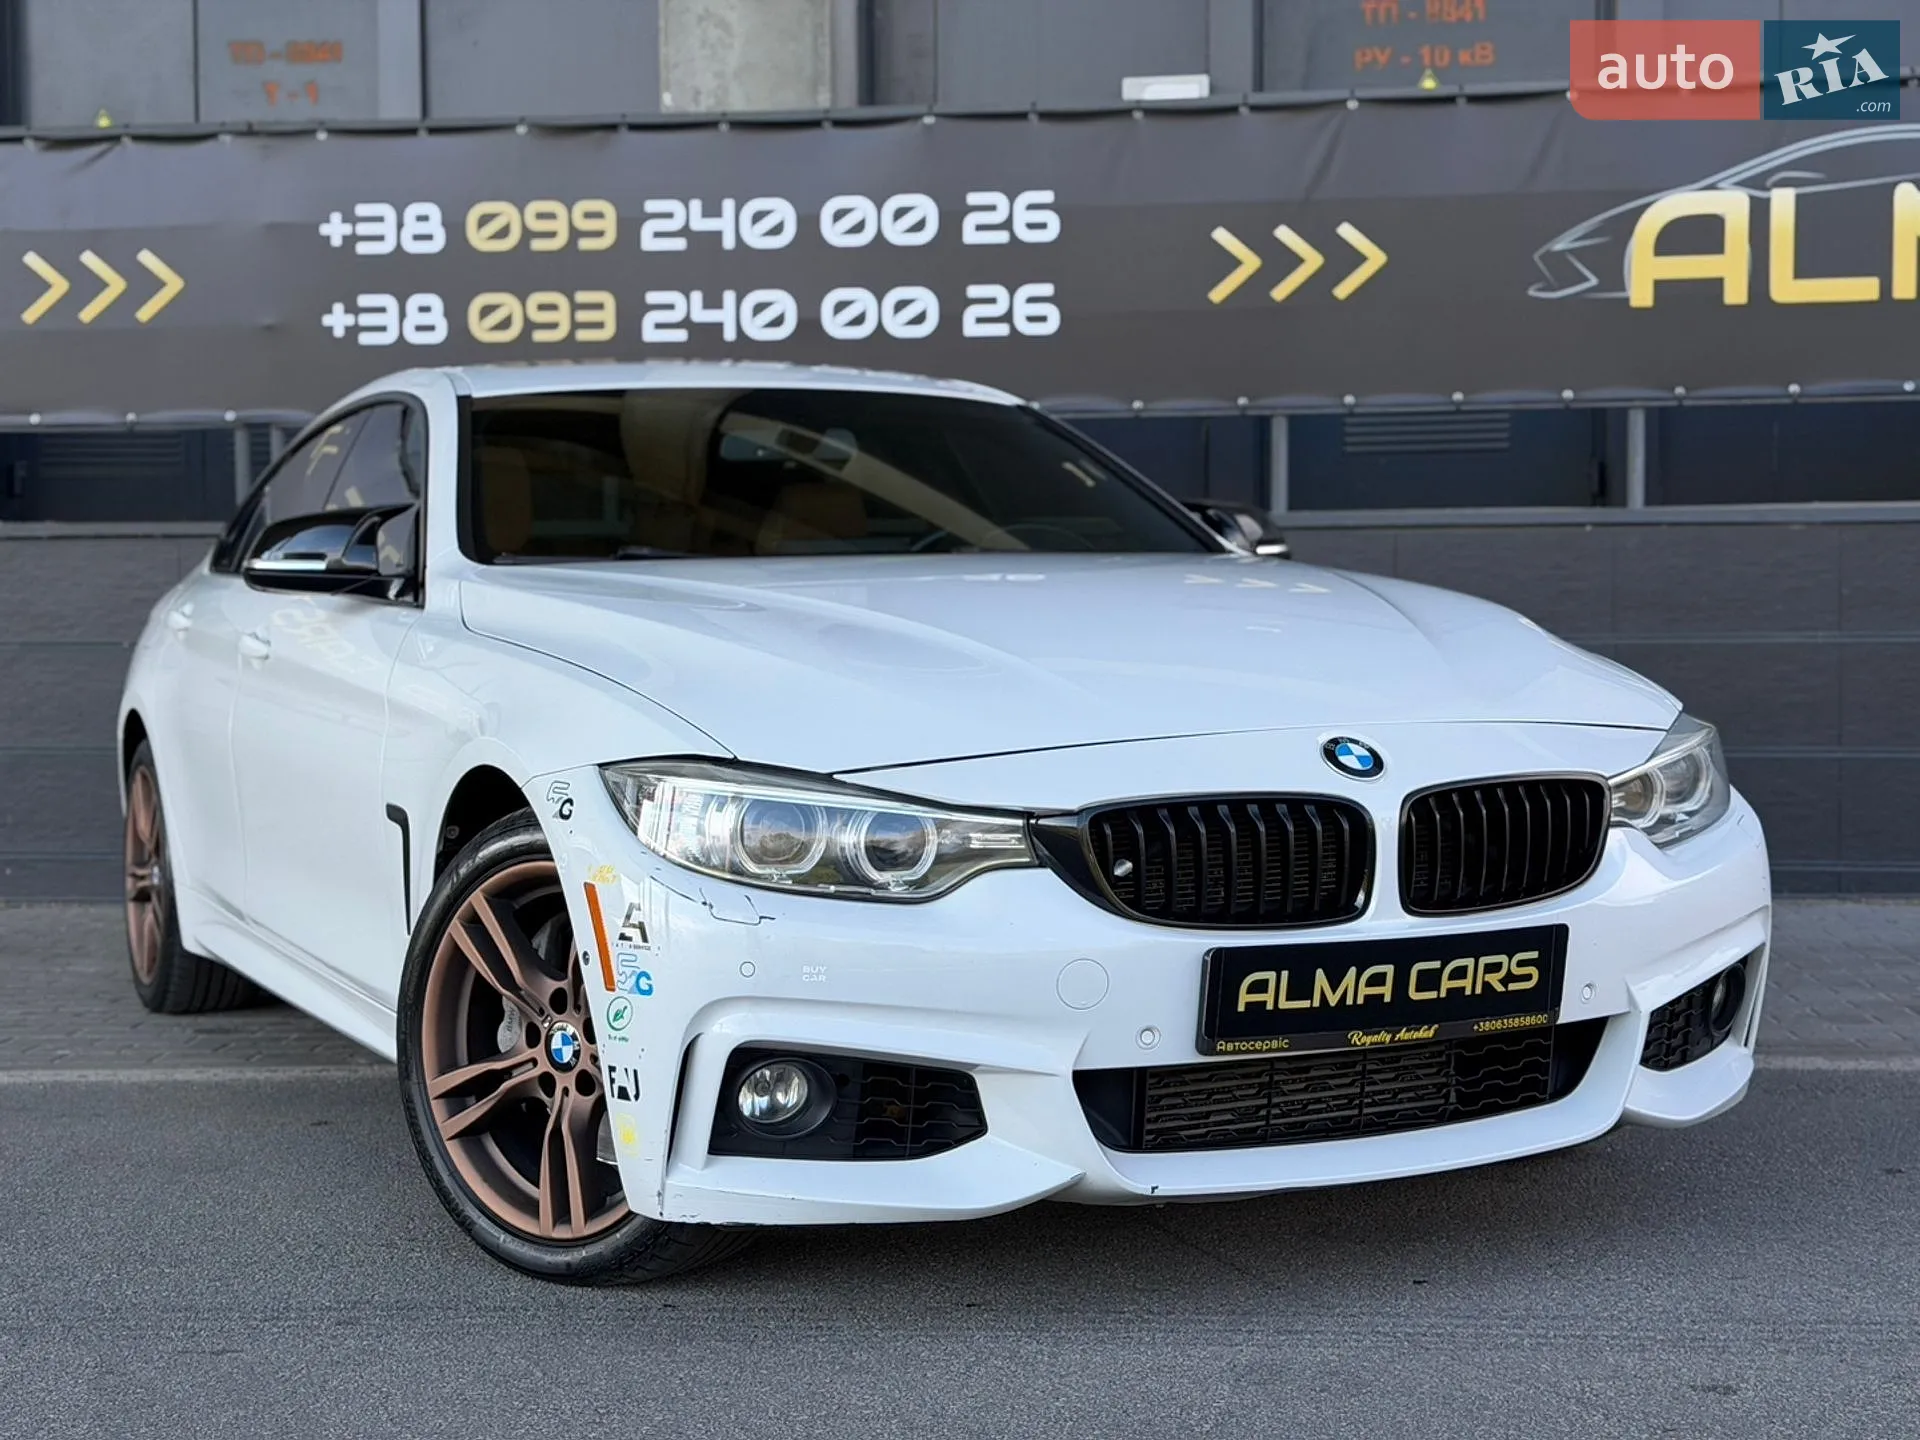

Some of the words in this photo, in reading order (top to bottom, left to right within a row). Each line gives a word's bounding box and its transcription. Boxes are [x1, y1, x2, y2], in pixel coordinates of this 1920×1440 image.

[318, 201, 447, 256] +38
[465, 199, 618, 252] 099
[640, 196, 798, 252] 240
[819, 193, 940, 248] 00
[961, 189, 1061, 245] 26
[1629, 182, 1920, 307] AL
[321, 292, 448, 346] +38
[467, 290, 617, 343] 093
[641, 289, 798, 343] 240
[819, 286, 940, 340] 00
[962, 282, 1061, 338] 26
[1236, 964, 1394, 1013] ALMA
[1408, 951, 1540, 1001] CARS
[1216, 1036, 1290, 1052] Автосервіс
